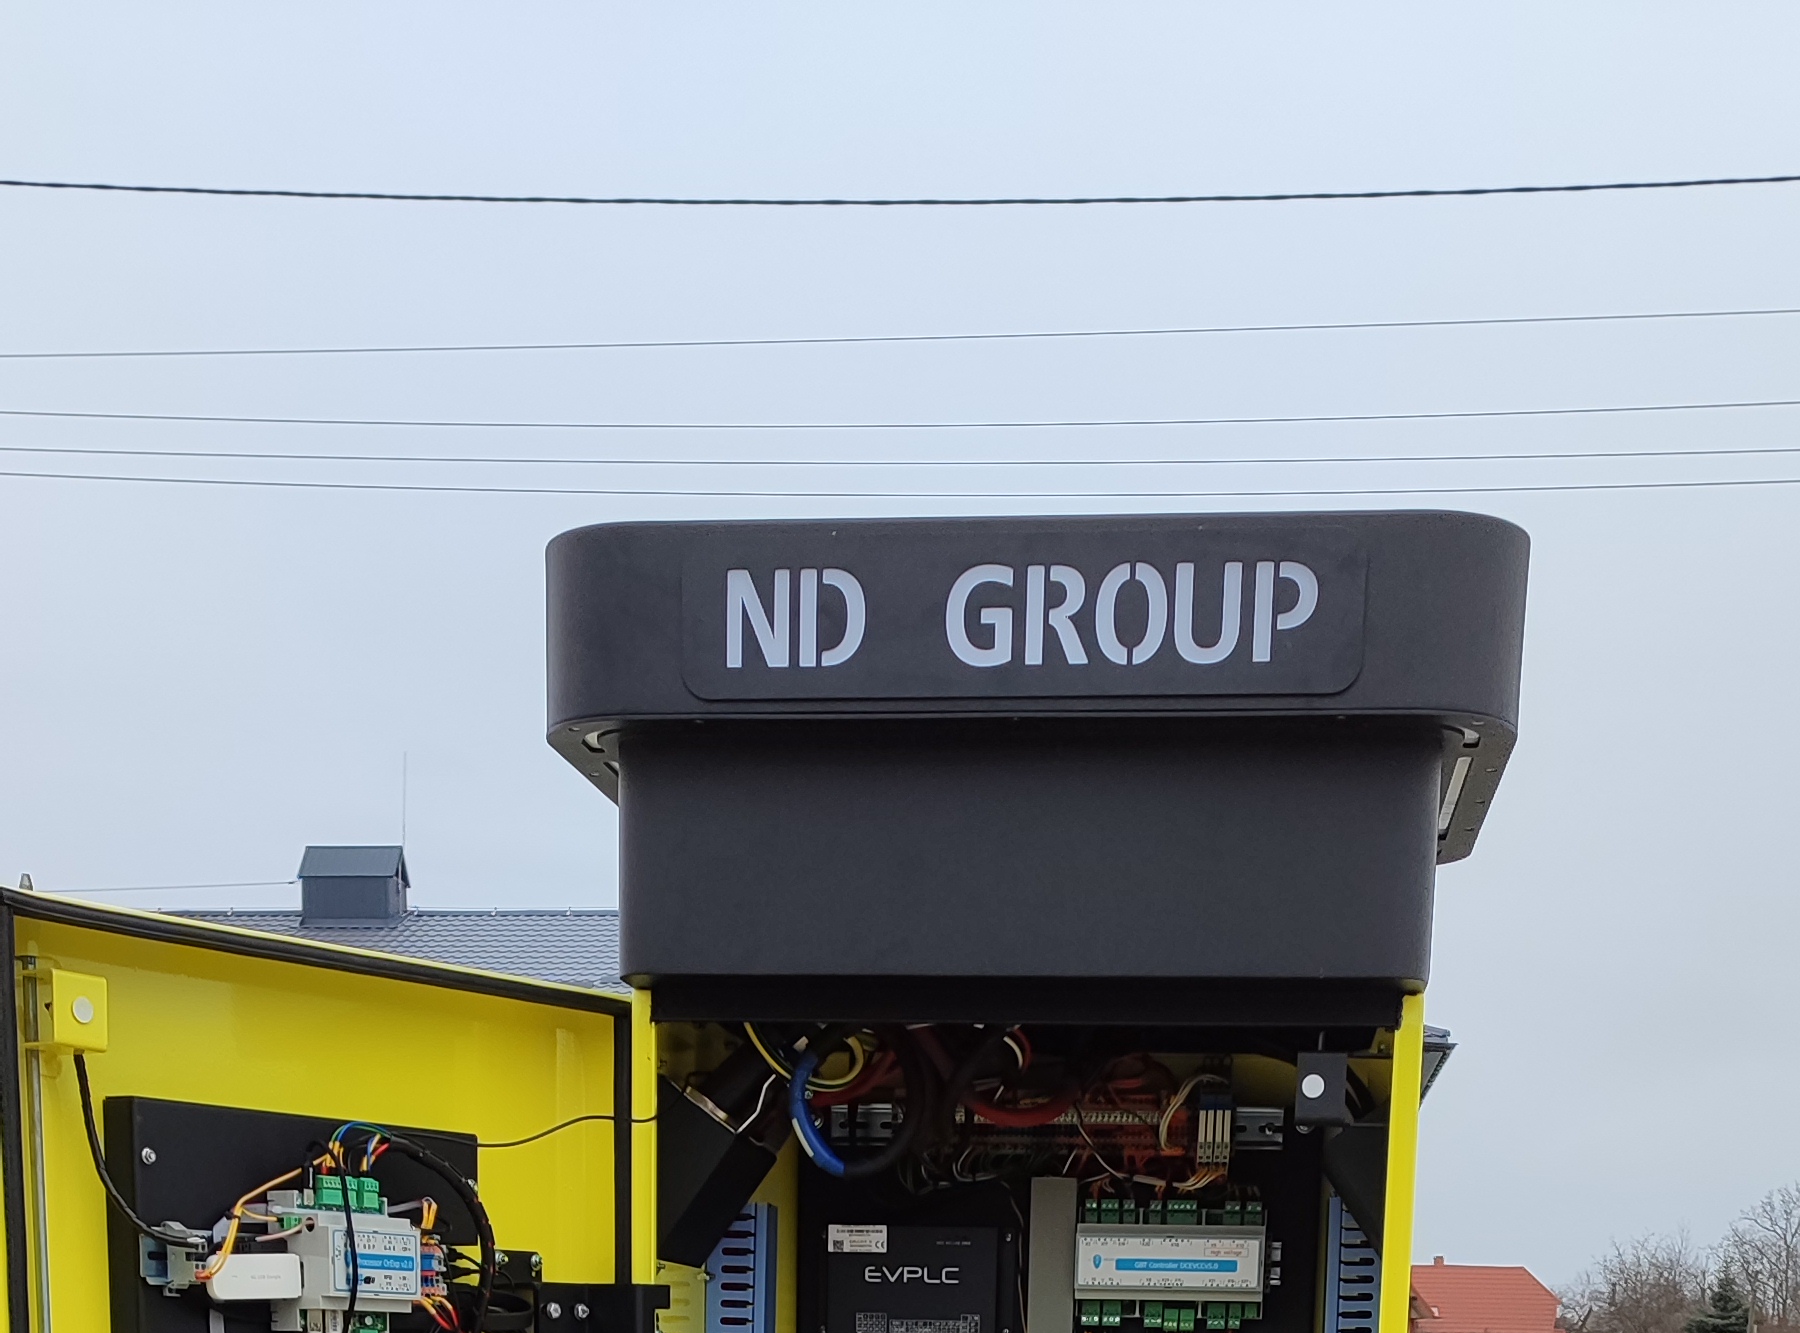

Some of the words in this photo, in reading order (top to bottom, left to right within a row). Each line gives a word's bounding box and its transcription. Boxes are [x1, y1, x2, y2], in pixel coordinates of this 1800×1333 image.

[725, 567, 866, 668] ND
[945, 560, 1319, 667] GROUP
[864, 1266, 960, 1284] EVPLC
[1149, 1262, 1179, 1270] Controller
